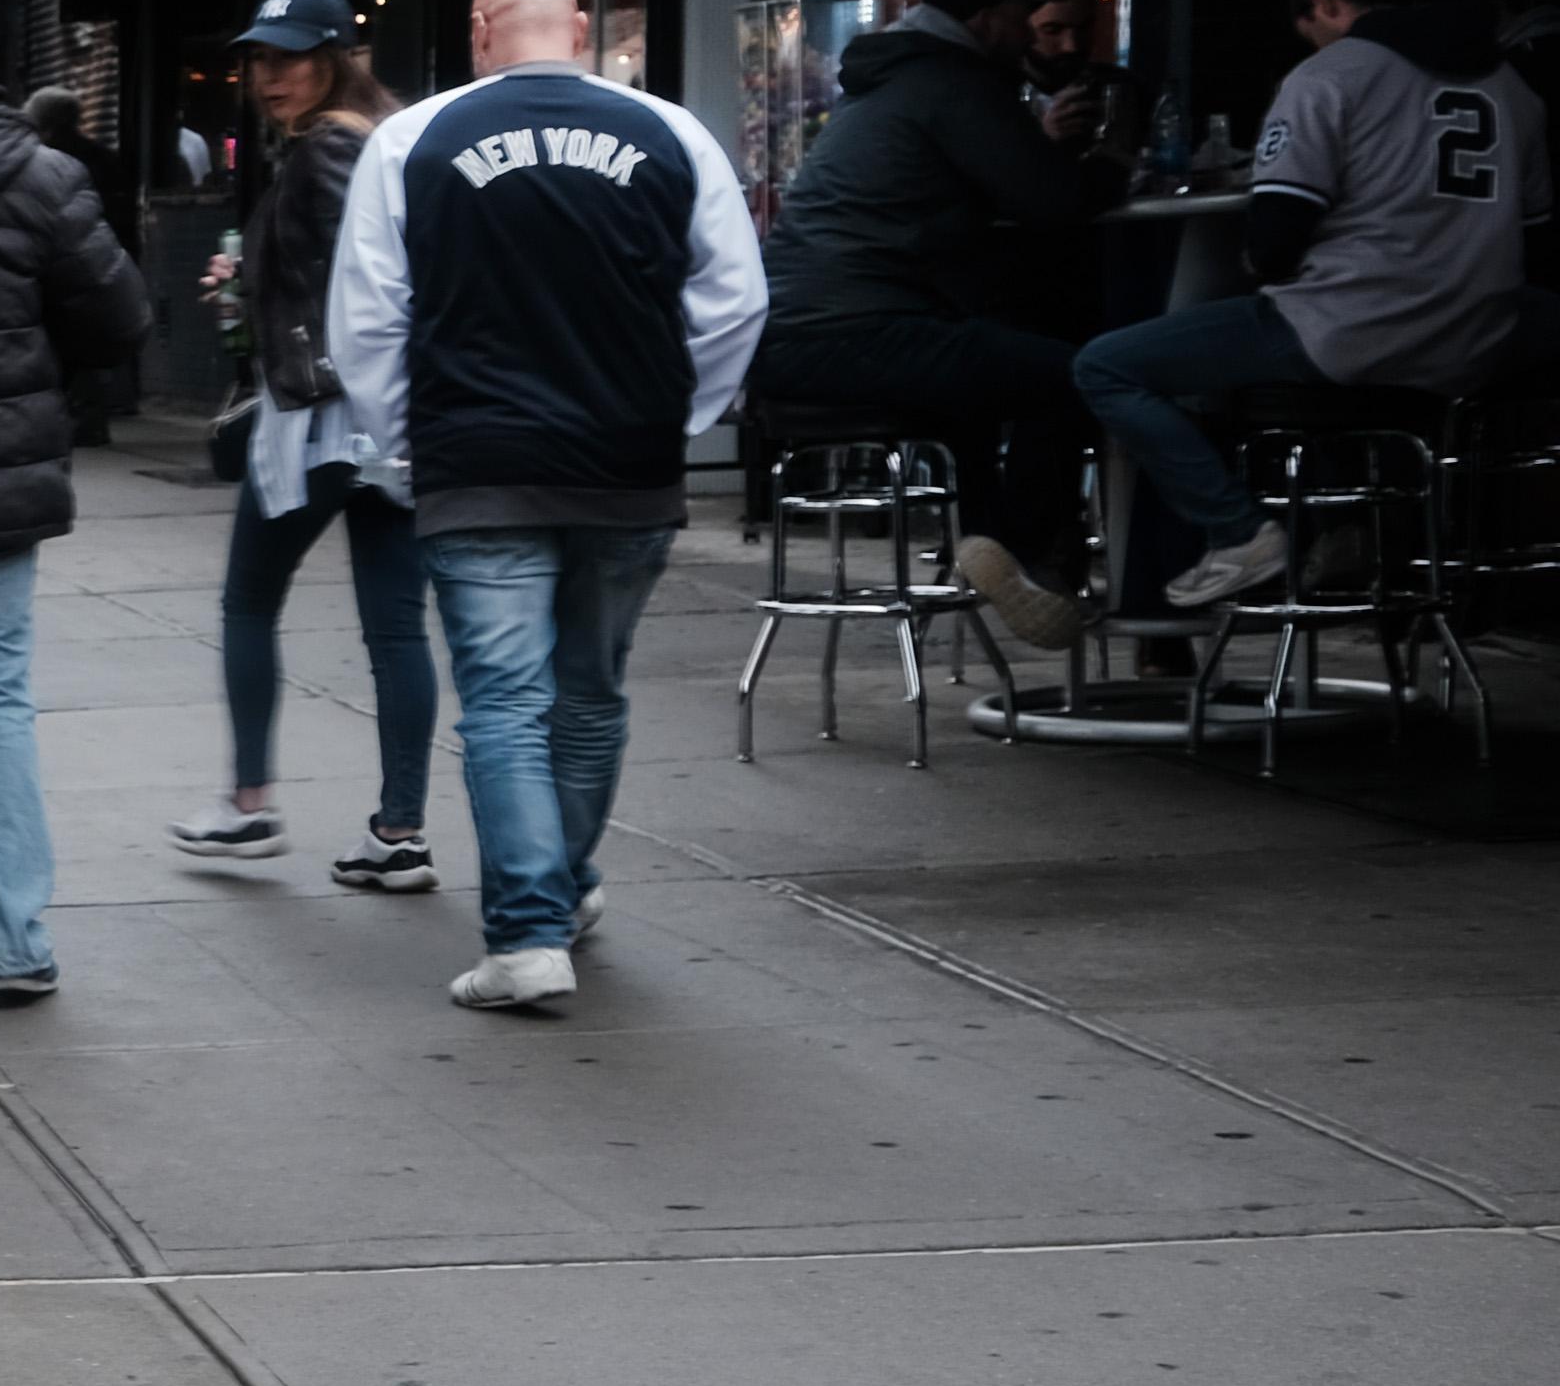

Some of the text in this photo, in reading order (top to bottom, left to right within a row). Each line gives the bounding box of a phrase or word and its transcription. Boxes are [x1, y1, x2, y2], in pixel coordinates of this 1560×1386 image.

[451, 127, 648, 189] NEW YORK
[1428, 87, 1500, 203] 2
